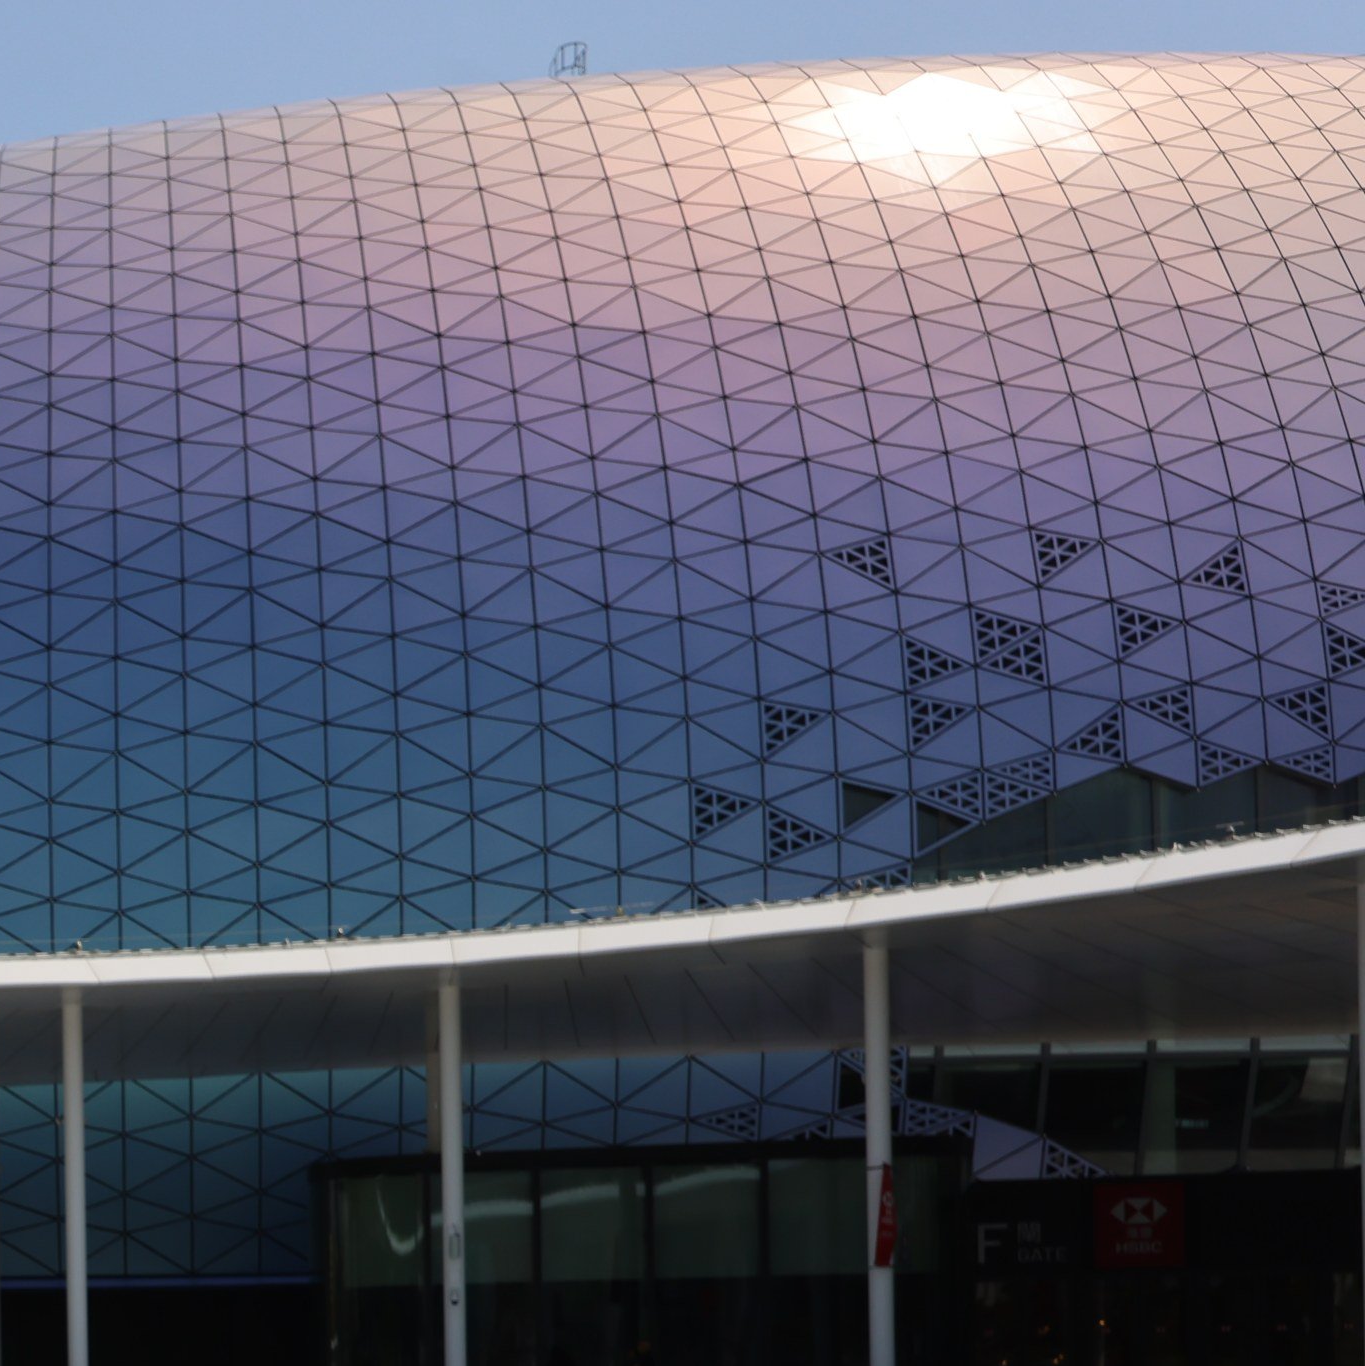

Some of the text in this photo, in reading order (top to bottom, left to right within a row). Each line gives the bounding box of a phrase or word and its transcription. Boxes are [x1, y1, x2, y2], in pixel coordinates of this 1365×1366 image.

[977, 1222, 1008, 1264] F
[1115, 1240, 1164, 1255] HSBC
[1017, 1244, 1069, 1264] GATE
